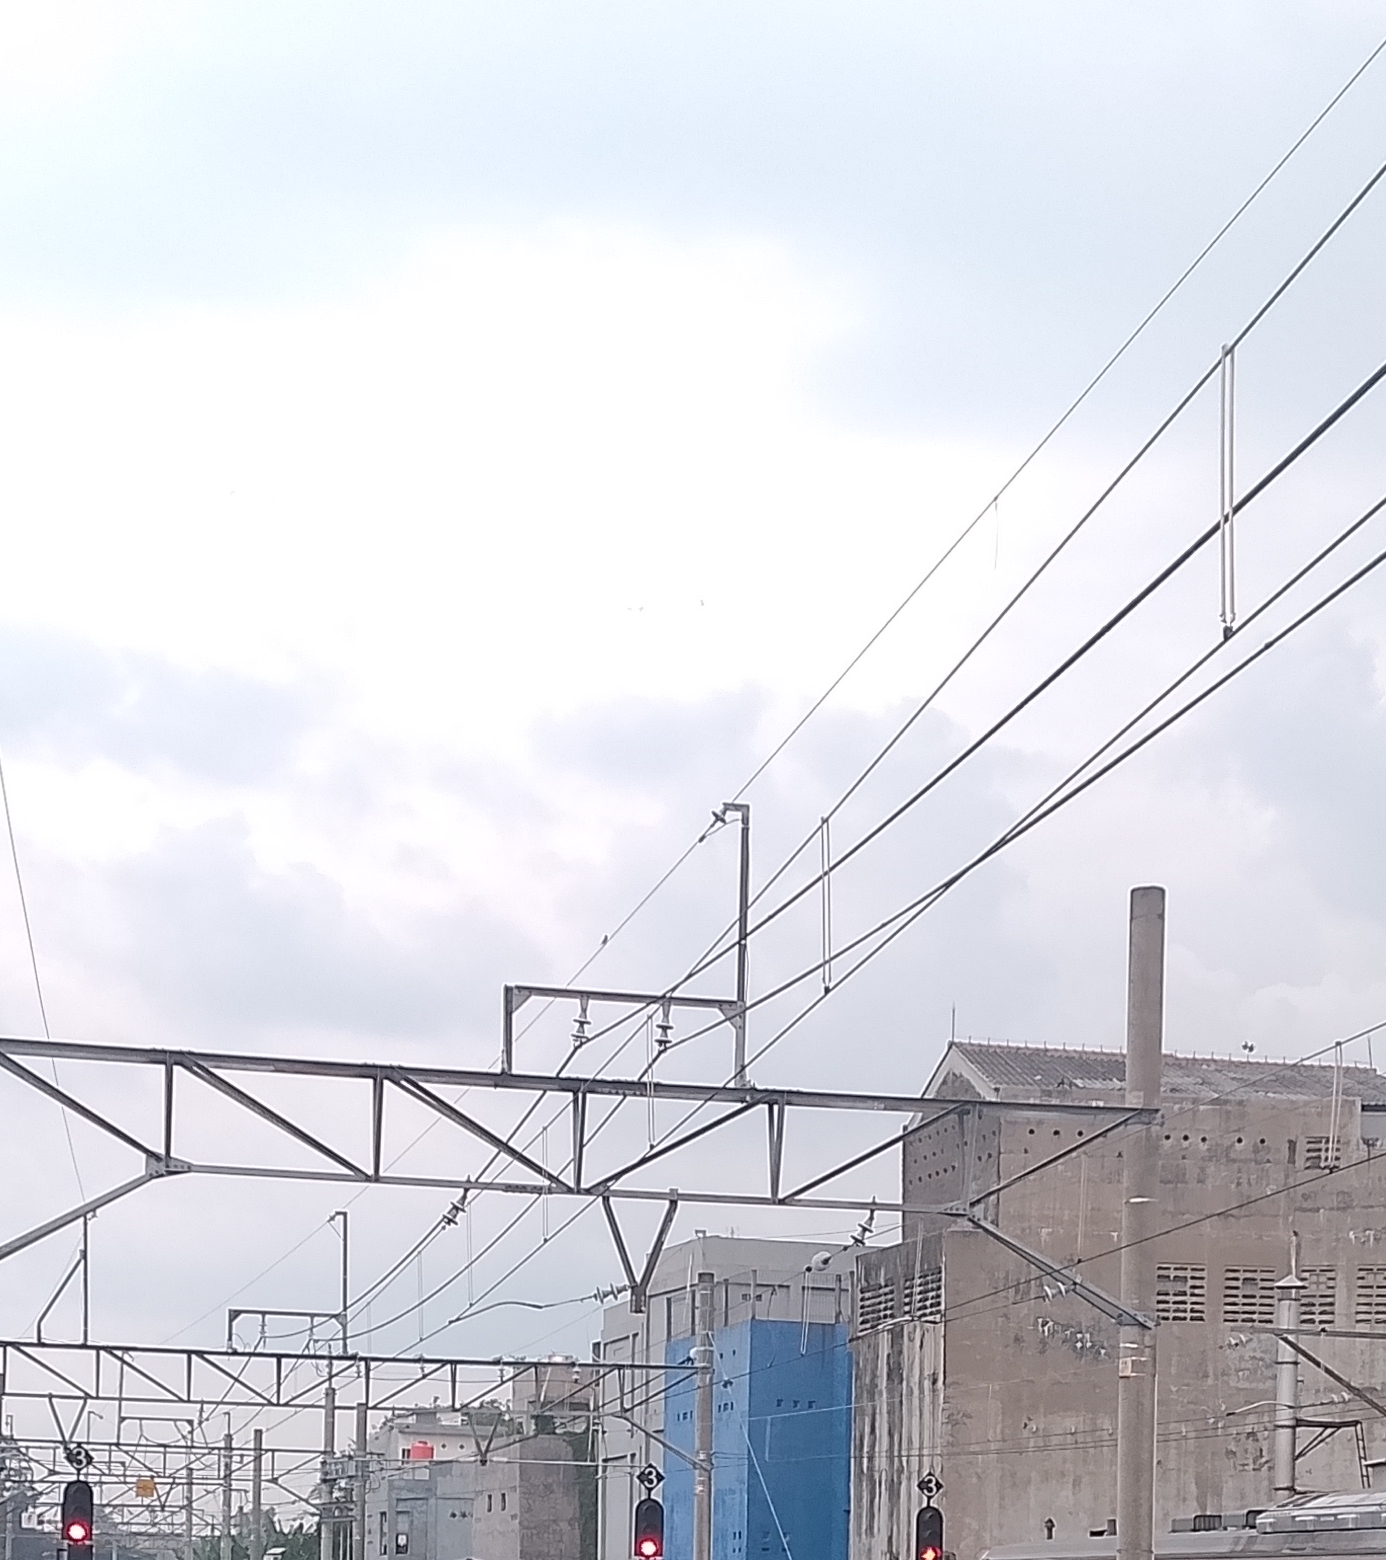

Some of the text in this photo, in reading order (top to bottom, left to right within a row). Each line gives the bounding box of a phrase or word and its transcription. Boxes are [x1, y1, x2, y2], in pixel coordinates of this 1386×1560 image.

[72, 1448, 87, 1469] 3
[644, 1468, 658, 1488] 3
[923, 1476, 937, 1496] 3
